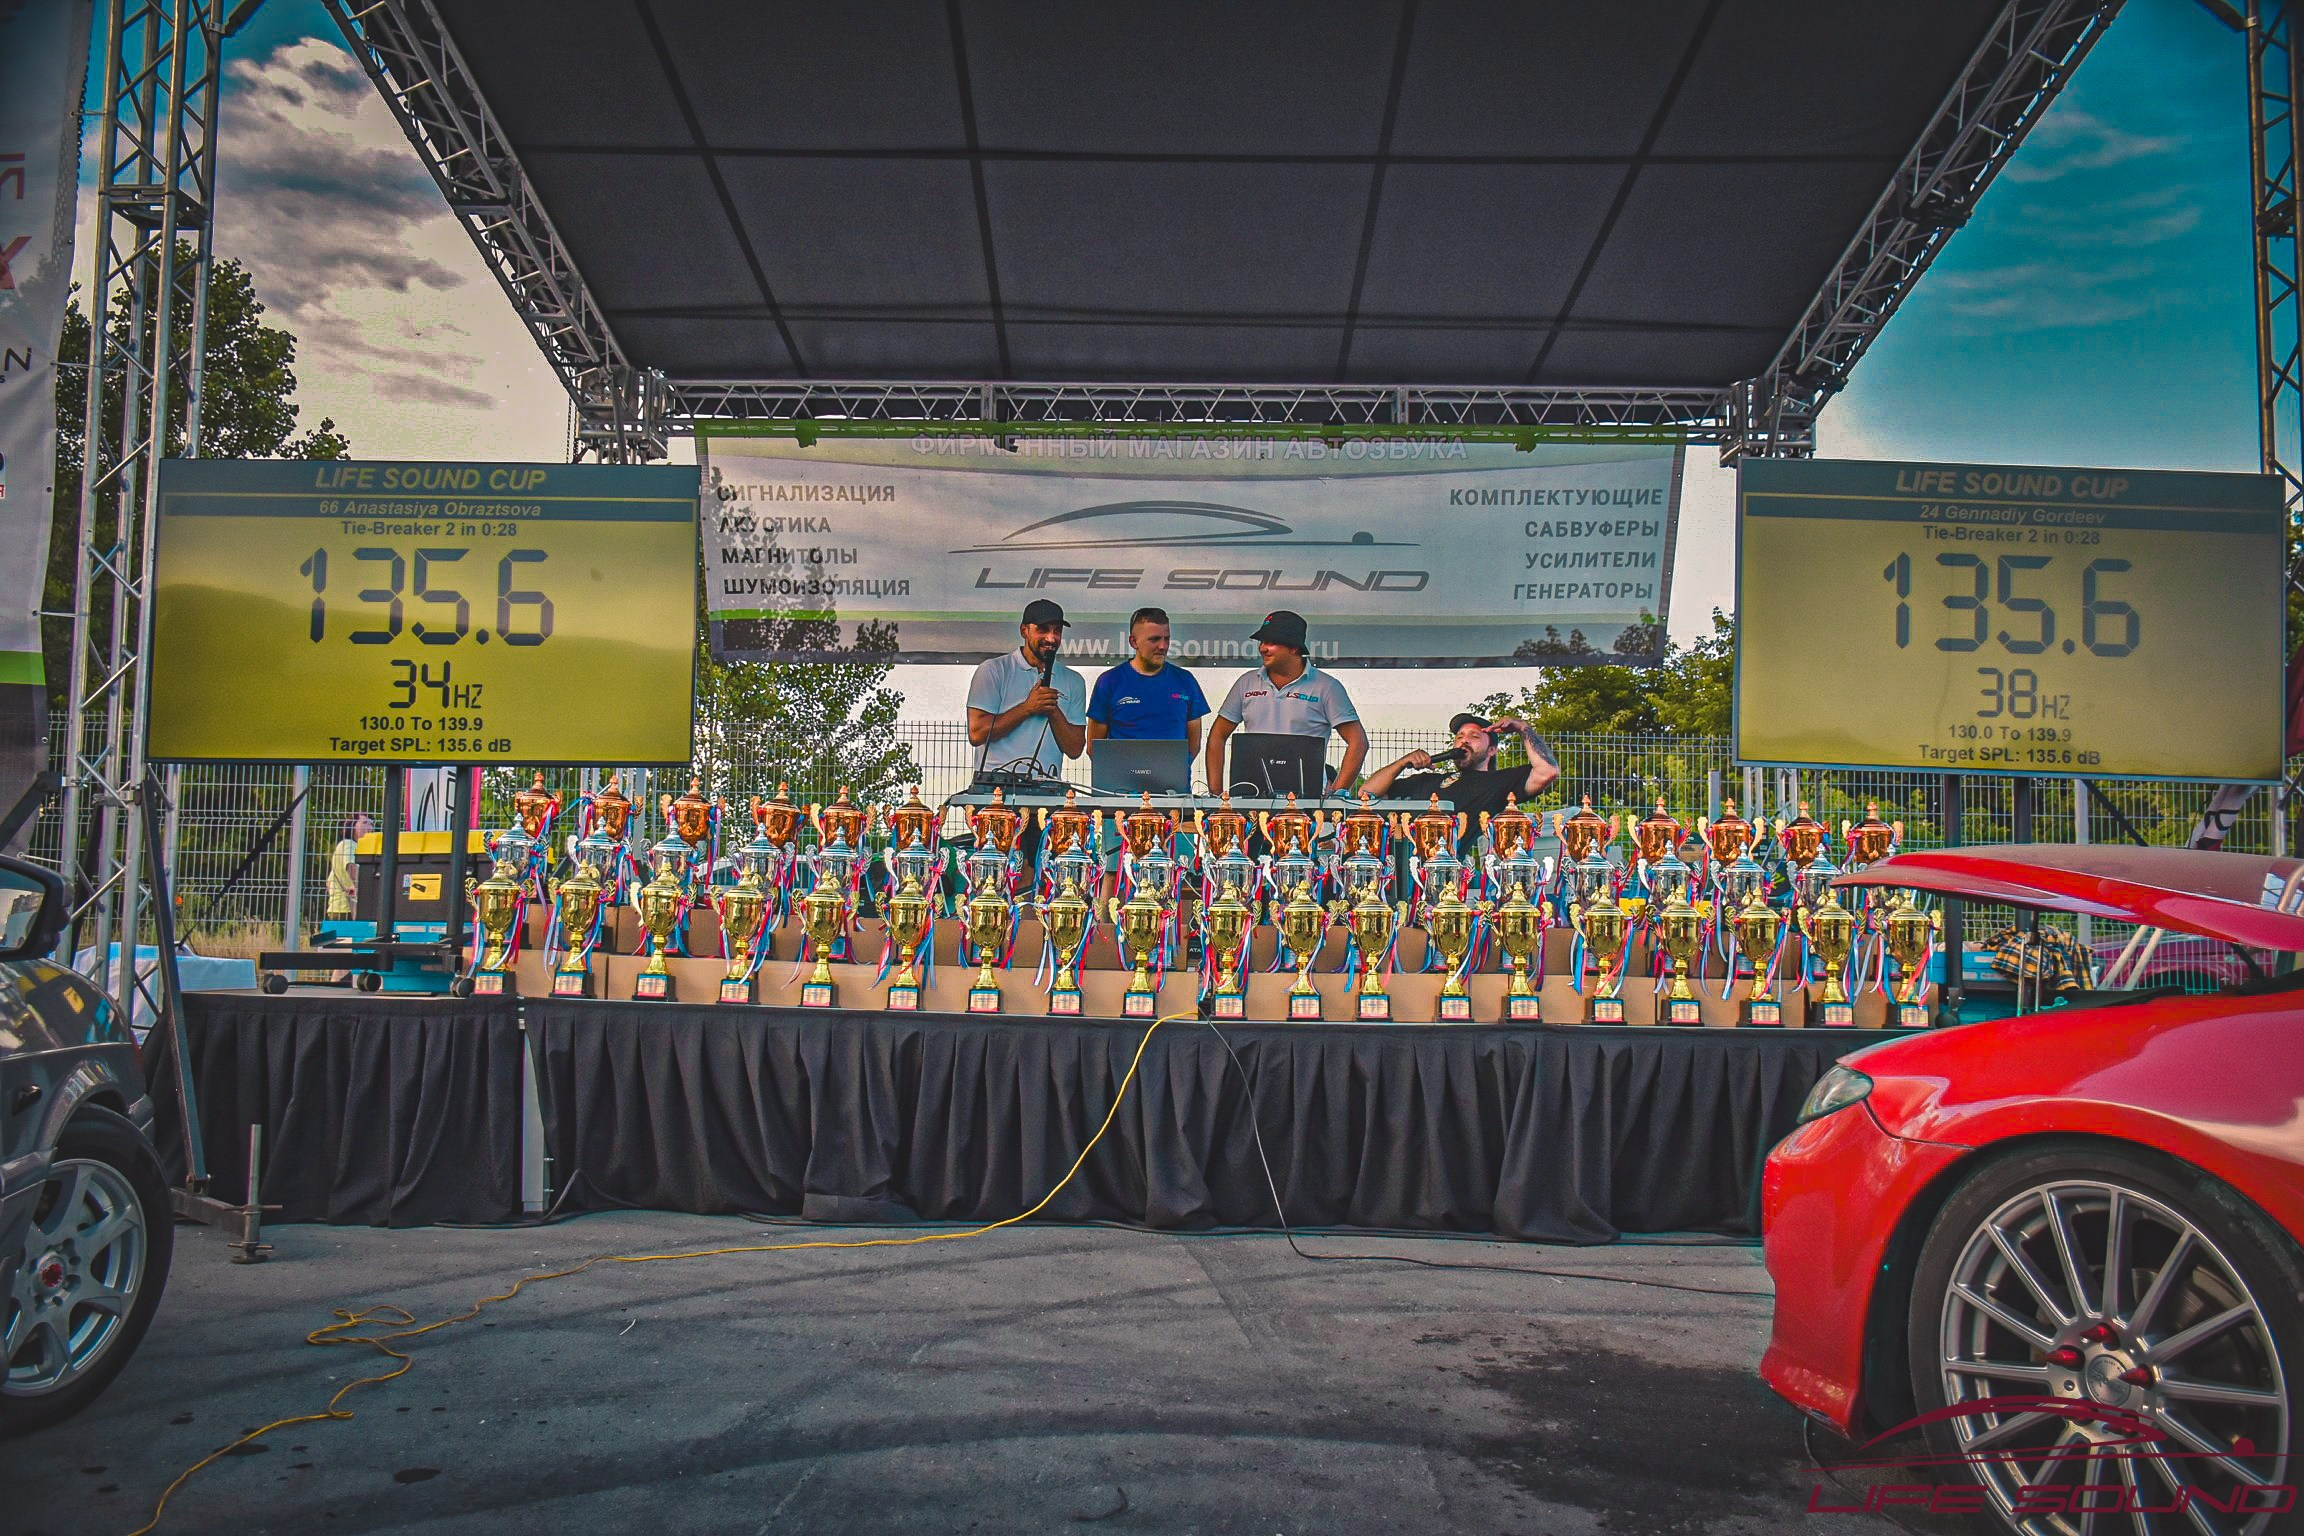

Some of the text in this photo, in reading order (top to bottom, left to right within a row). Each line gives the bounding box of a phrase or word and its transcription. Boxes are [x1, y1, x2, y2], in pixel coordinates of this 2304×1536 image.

[911, 428, 1469, 461] ФИРМЕННЫЙ МАГАЗИН АВТОЗВУКА
[315, 467, 547, 490] LIFE SOUND CUP
[1896, 470, 2129, 499] LIFE SOUND CUP
[717, 485, 895, 505] СИГНАЛИЗАЦИЯ
[1450, 488, 1663, 508] КОМПЛЕКТУЮЩИЕ
[319, 500, 541, 518] 66 Anastasiya Obraztsova
[1920, 505, 2105, 525] 24 Gennadiy Gordeev
[341, 521, 517, 536] Tie-Breaker 2 in 0:28
[719, 517, 832, 533] АКУСТИКА
[1525, 520, 1659, 538] САБВУФЕРЫ
[1922, 525, 2100, 545] Tie-Breaker 2 in 0:28
[722, 548, 858, 565] МАГНИТОЛЫ
[1525, 551, 1655, 569] УСИЛИТЕЛИ
[724, 578, 910, 598] ШУМОИЗОЛЯЦИЯ
[974, 567, 1430, 592] LIFE SOUND
[300, 547, 554, 646] 135.6
[1513, 583, 1653, 600] ГЕНЕРАТОРЫ
[1883, 551, 2140, 658] 135.6
[388, 659, 450, 709] 34
[1977, 667, 2038, 719] 38
[360, 717, 483, 731] 130.0 To 139.9
[1949, 725, 2071, 742] 130.0 To 139.9
[329, 737, 511, 755] Target SPL: 135.6 dB
[1918, 745, 2100, 765] Target SPL: 135.6 dB
